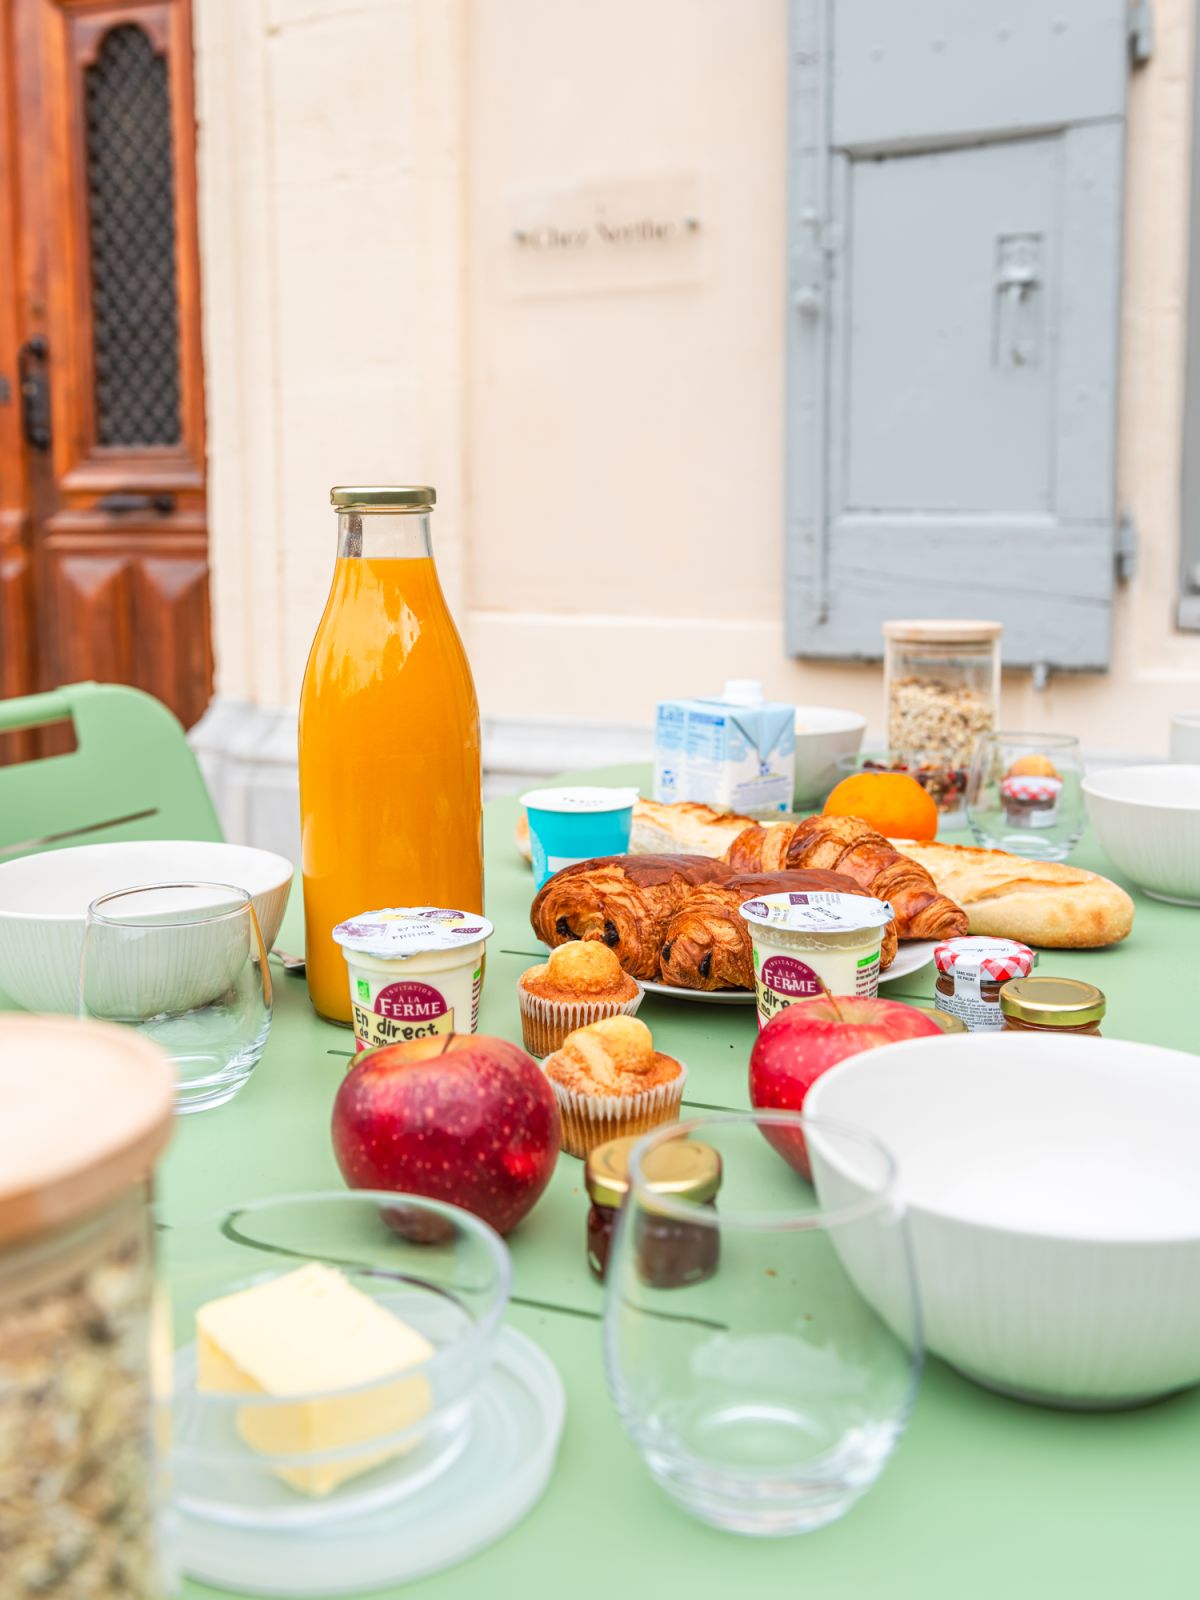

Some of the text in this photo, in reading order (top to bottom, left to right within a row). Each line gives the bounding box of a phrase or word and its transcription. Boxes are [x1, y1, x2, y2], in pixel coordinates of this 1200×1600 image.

[768, 959, 808, 975] INVITATION
[385, 984, 433, 997] INVITATION
[763, 968, 817, 993] FERME
[378, 997, 441, 1017] FERME
[762, 987, 791, 1009] dire
[354, 1006, 439, 1041] En direct
[359, 1027, 369, 1039] de
